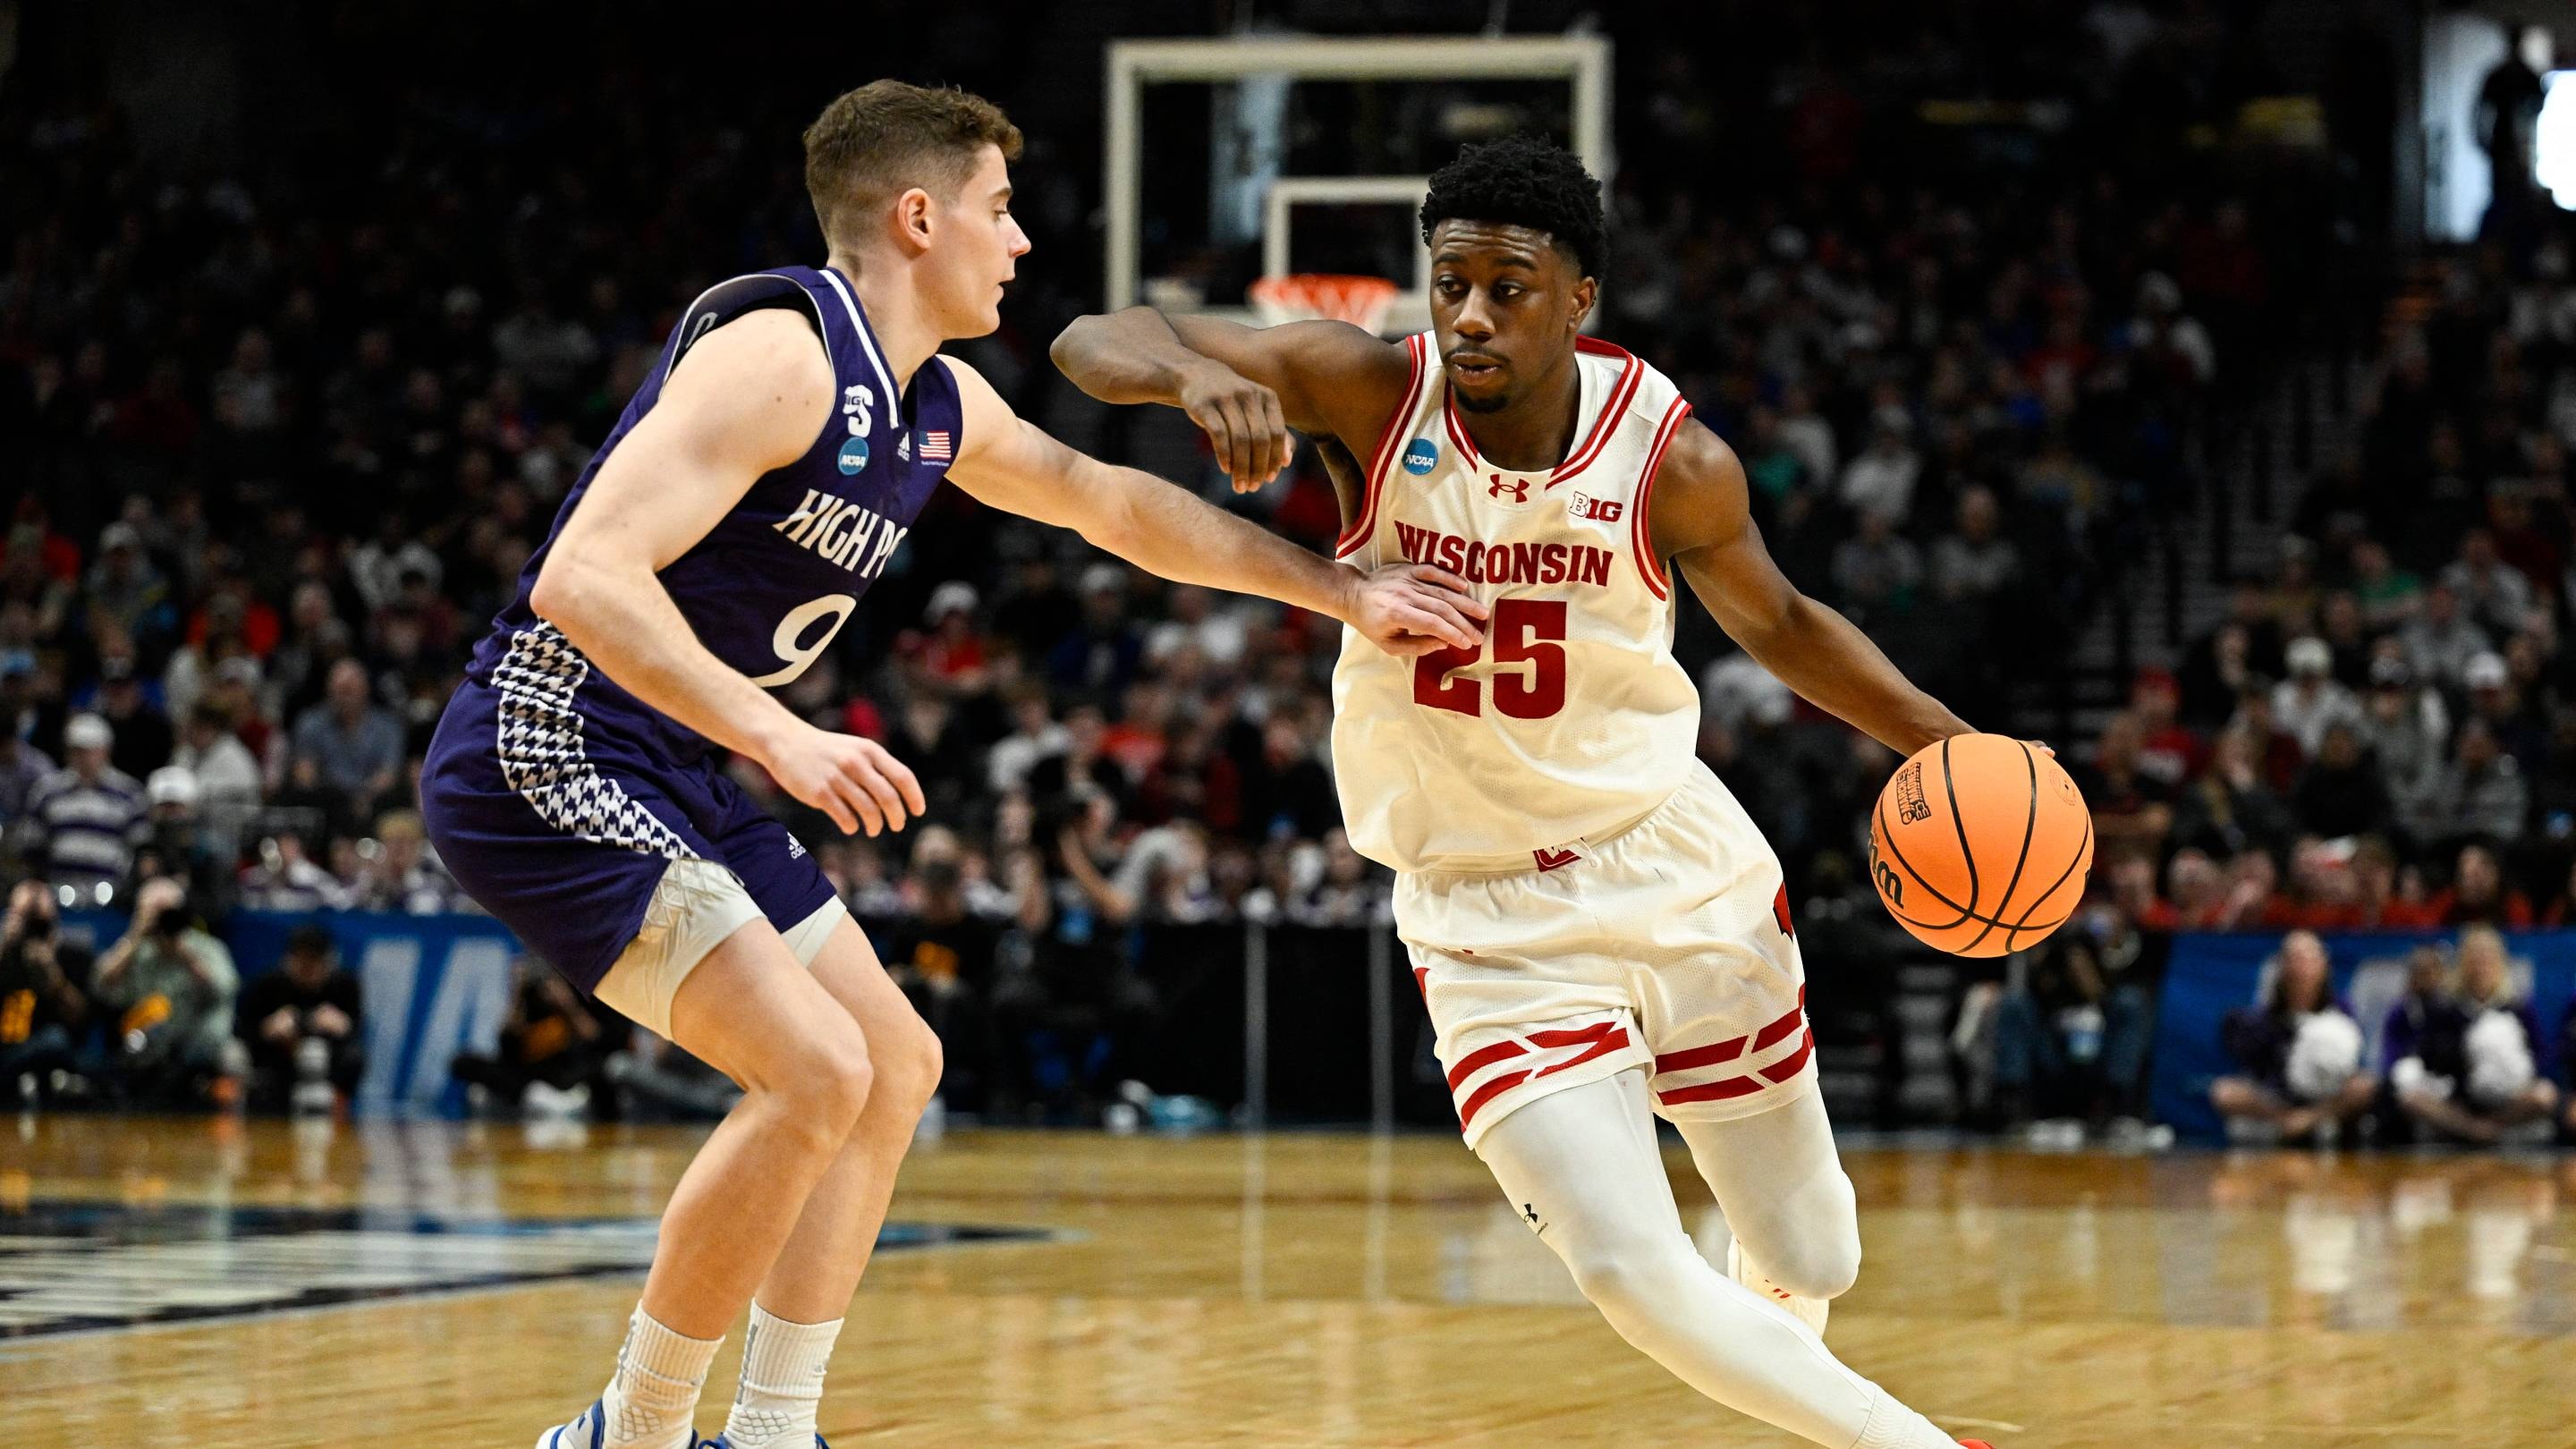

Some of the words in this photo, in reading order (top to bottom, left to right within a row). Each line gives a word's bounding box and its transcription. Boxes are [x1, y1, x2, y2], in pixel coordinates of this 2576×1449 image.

[1405, 453, 1435, 469] NCAA
[771, 487, 880, 572] HIGH
[1568, 490, 1623, 522] BIG
[1394, 520, 1614, 587] WISCONSIN
[750, 594, 857, 688] 9
[1414, 598, 1568, 720] 25
